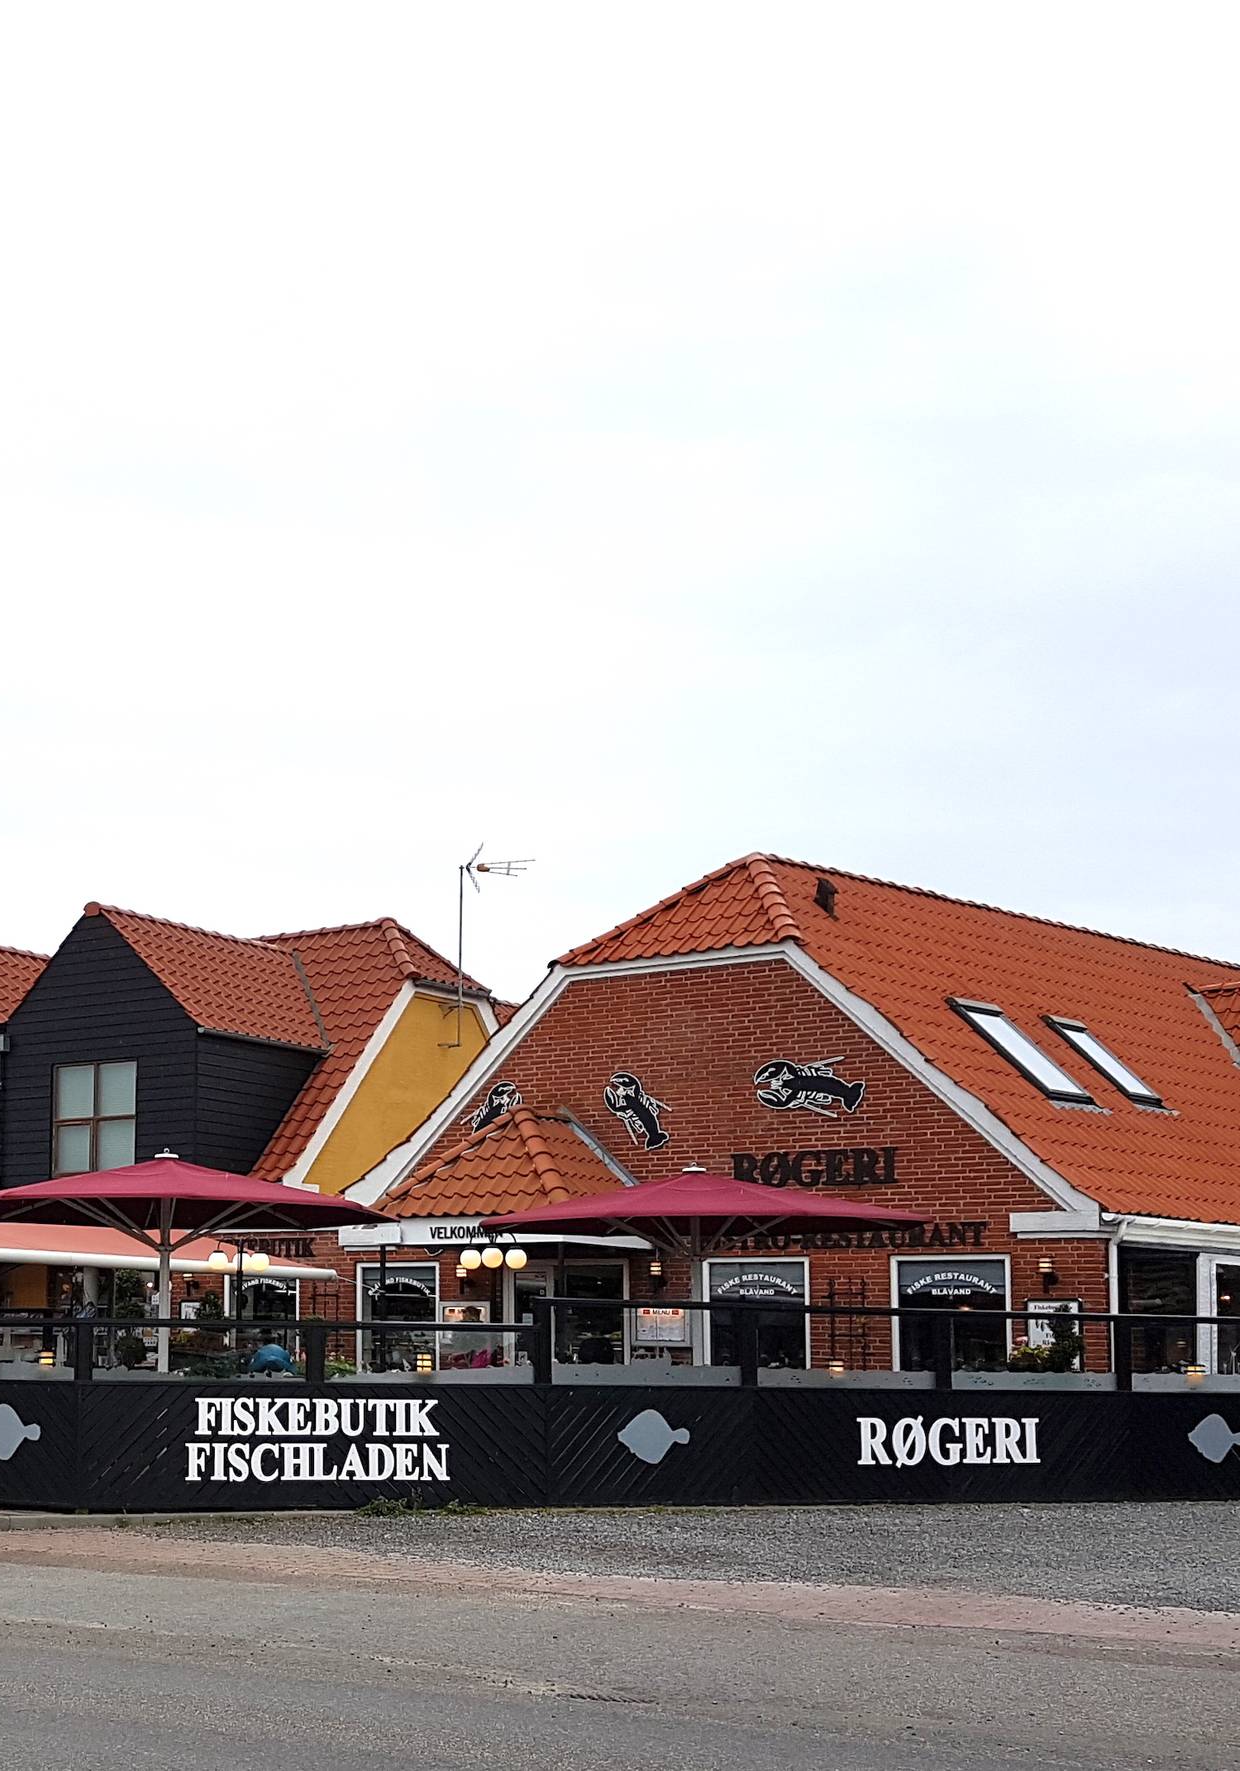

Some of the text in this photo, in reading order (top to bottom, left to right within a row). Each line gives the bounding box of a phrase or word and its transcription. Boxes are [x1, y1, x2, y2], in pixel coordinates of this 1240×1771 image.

[731, 1147, 898, 1187] RØGERI
[741, 1273, 798, 1295] RESTAURANT
[907, 1272, 998, 1295] FISKE RESTAURANT
[194, 1397, 440, 1436] FISKEBUTIK
[857, 1415, 1041, 1468] RØGERI
[184, 1442, 451, 1482] FISCHLADEN
